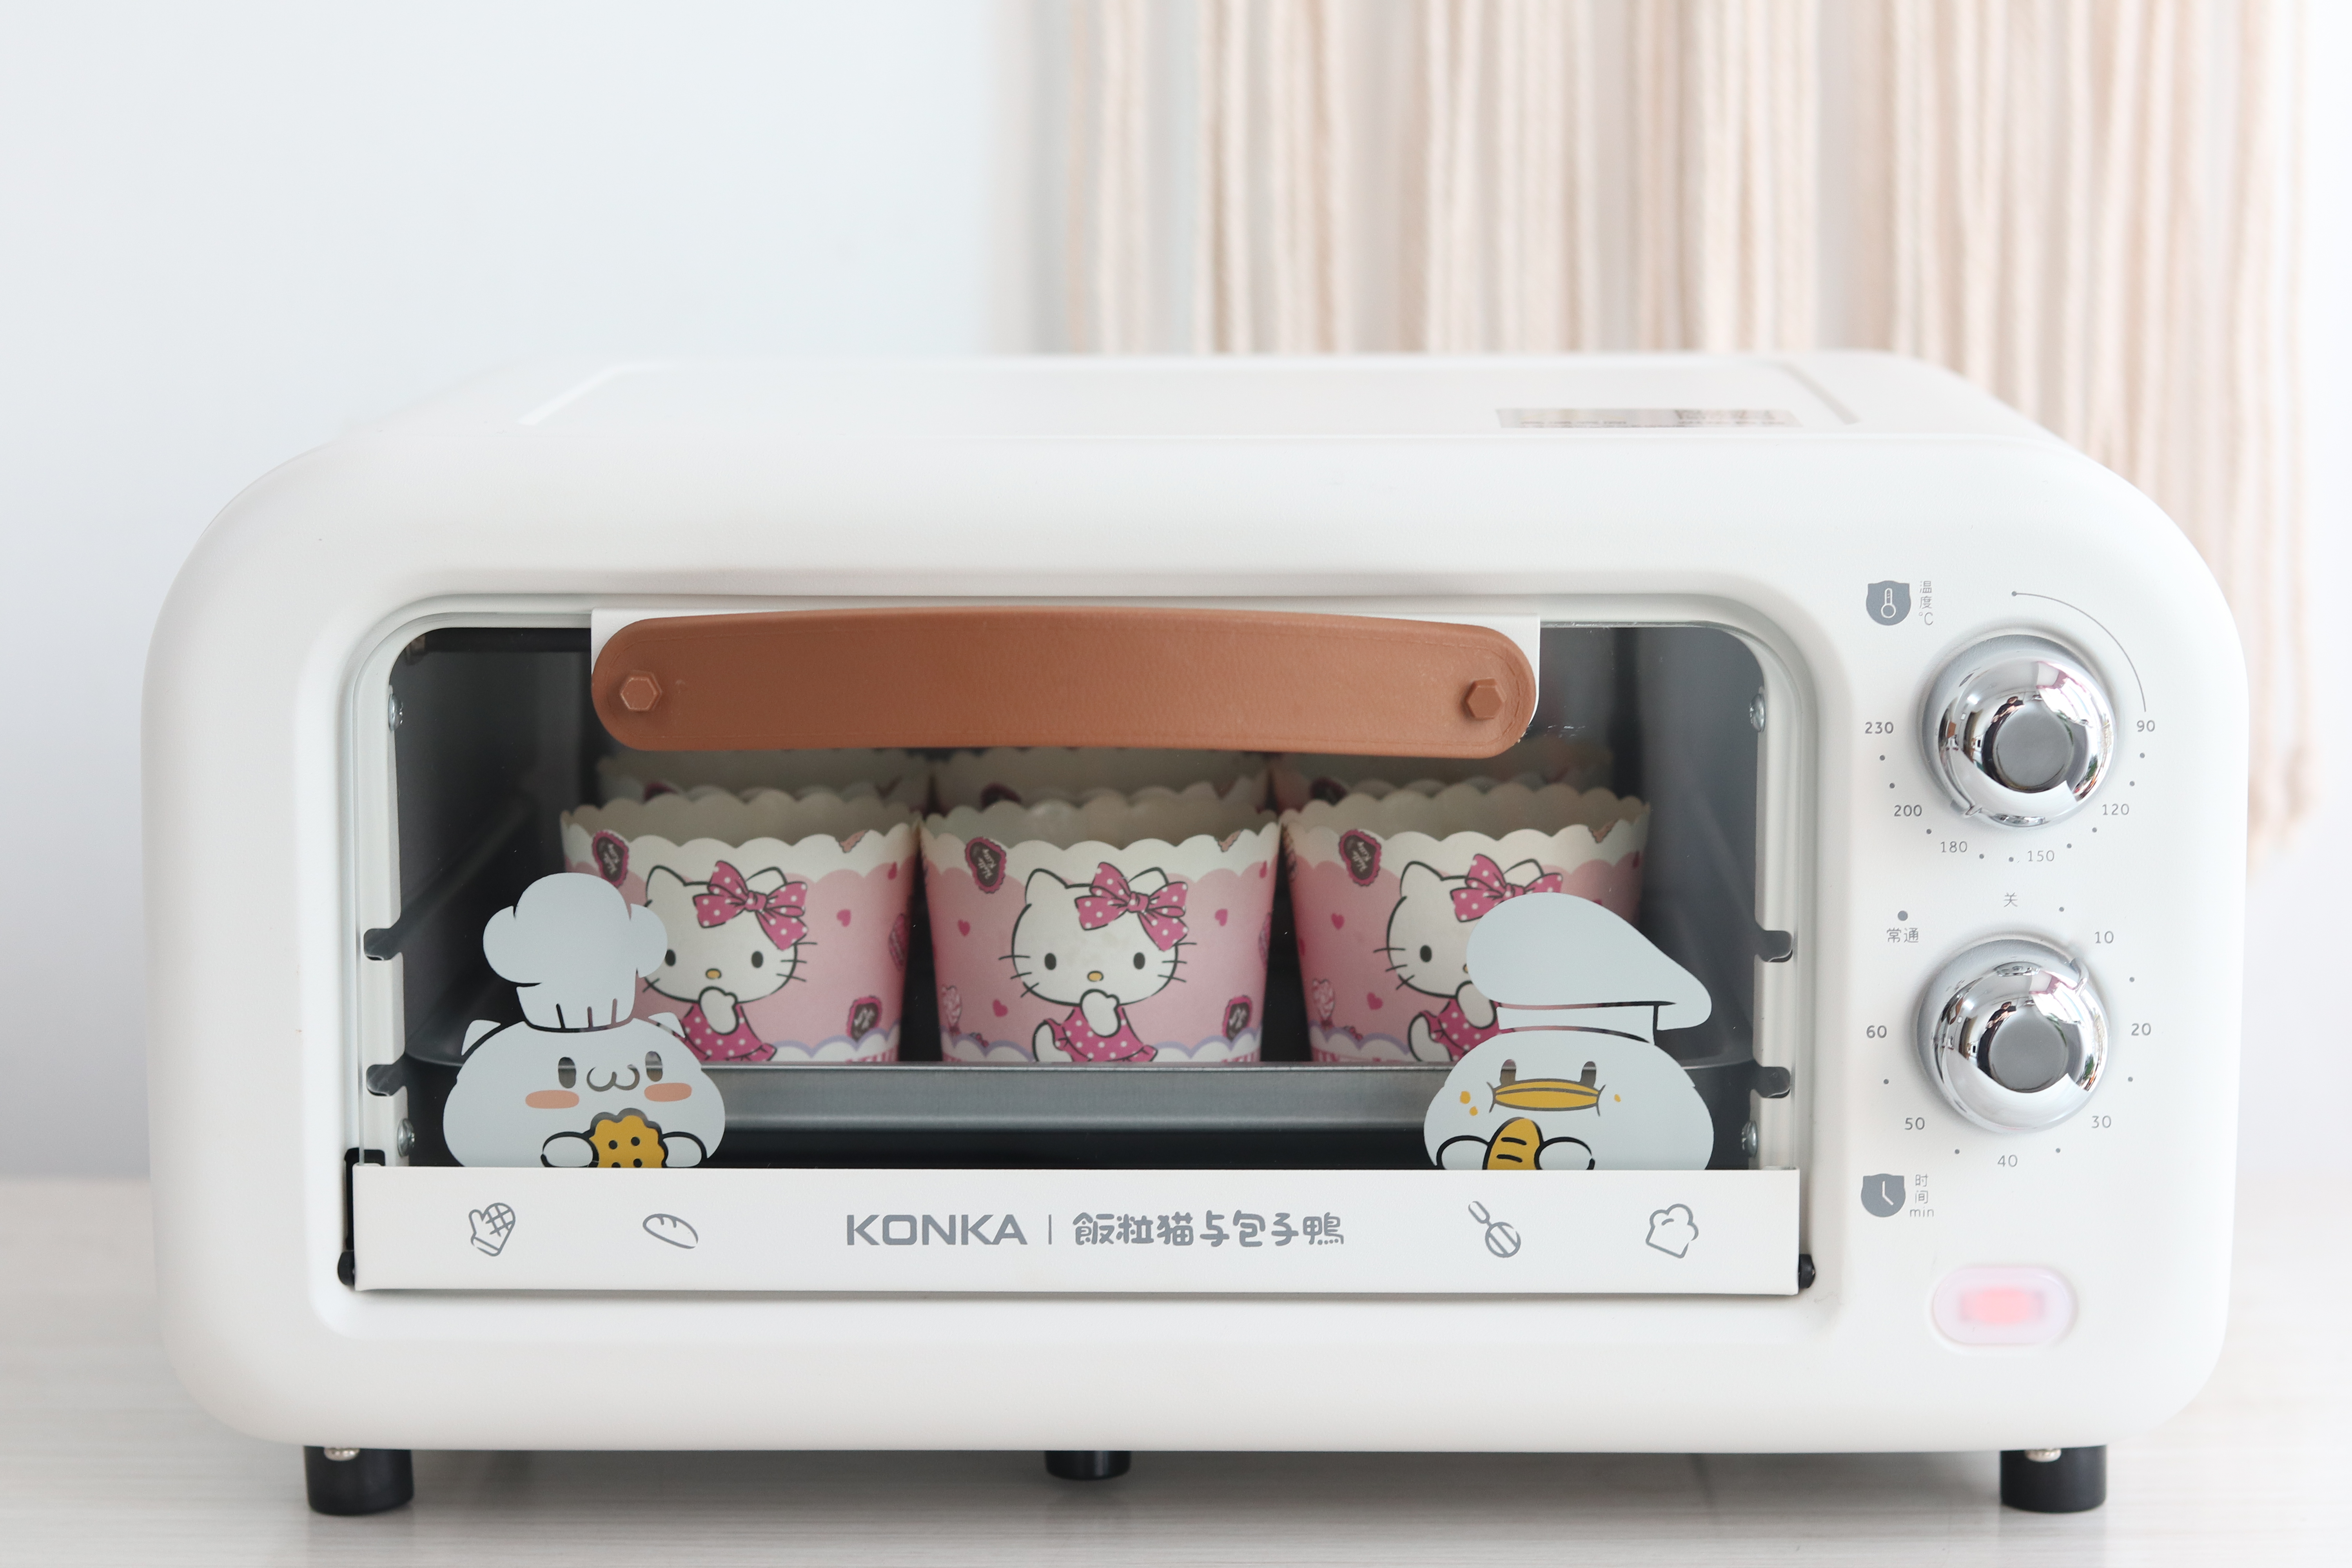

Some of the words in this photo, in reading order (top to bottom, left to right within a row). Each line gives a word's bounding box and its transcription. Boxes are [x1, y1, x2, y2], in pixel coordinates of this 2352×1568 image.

[1920, 581, 1932, 609] 温度
[1865, 721, 1894, 734] 230
[2136, 720, 2155, 732] 90
[1894, 804, 1922, 817] 200
[2102, 803, 2129, 815] 120
[1940, 841, 1967, 853] 180
[2027, 850, 2055, 862] 150
[2004, 893, 2017, 907] 关
[1886, 927, 1918, 943] 常通
[2095, 931, 2114, 944] 10
[1866, 1025, 1887, 1038] 60
[2131, 1023, 2151, 1036] 20
[1905, 1117, 1925, 1130] 50
[2092, 1115, 2112, 1129] 30
[1997, 1154, 2018, 1167] 40
[1915, 1174, 1928, 1204] 时间
[1909, 1206, 1934, 1217] min
[846, 1214, 1028, 1246] KONKA
